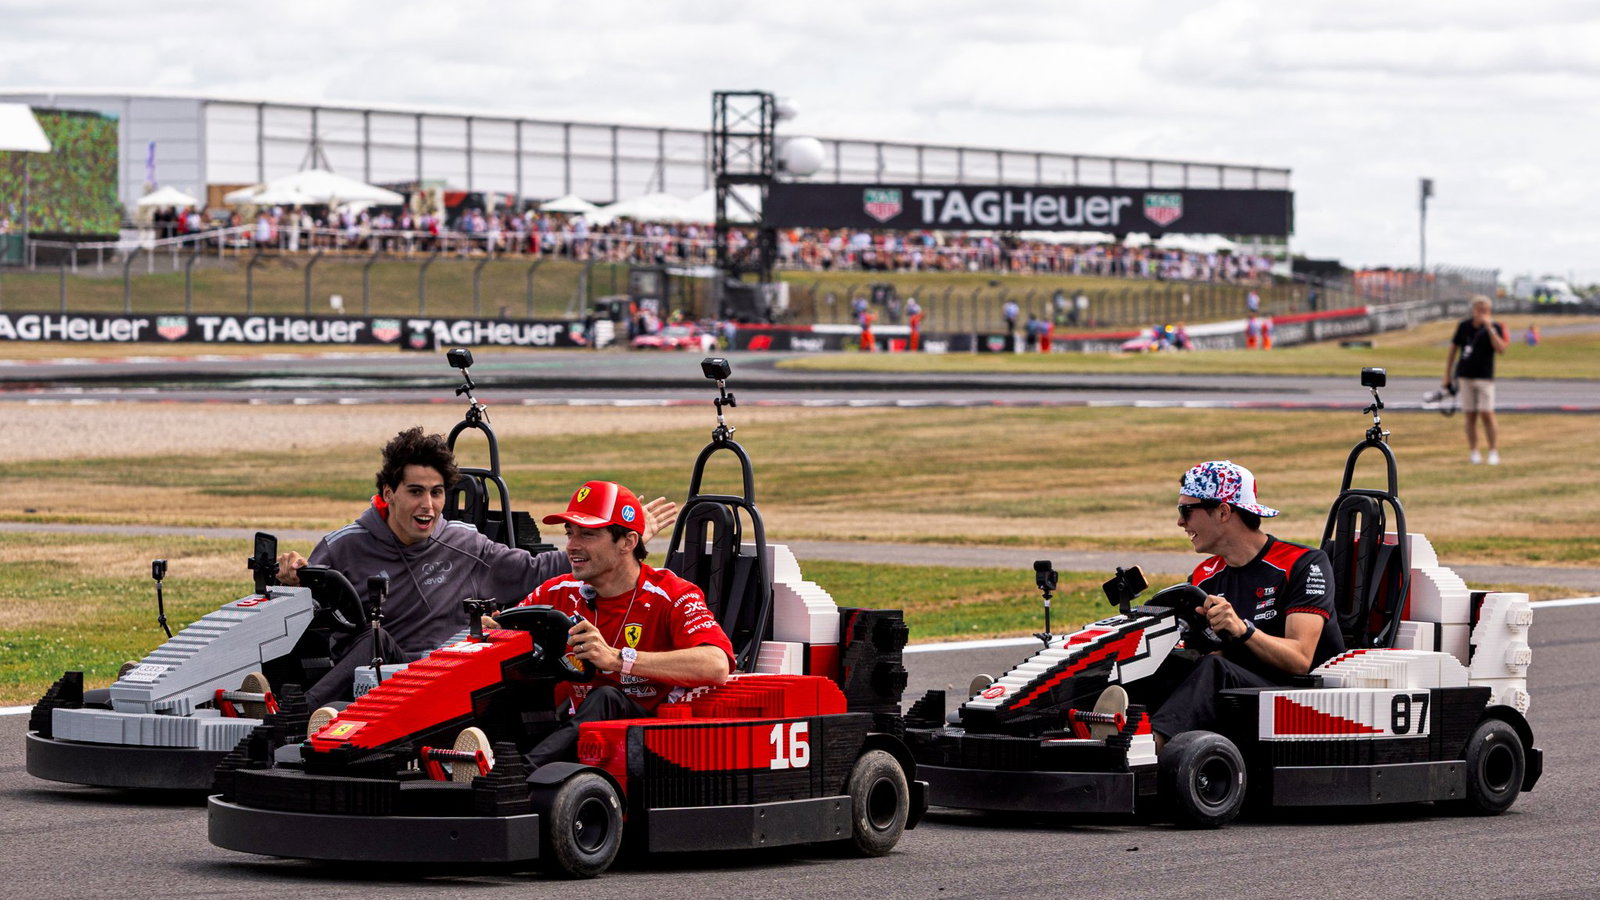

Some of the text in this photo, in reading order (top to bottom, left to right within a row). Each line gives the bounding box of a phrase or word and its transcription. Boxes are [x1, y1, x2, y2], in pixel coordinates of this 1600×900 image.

[0, 315, 149, 341] AGHeuer
[1391, 693, 1430, 735] 87
[770, 721, 810, 770] 16
